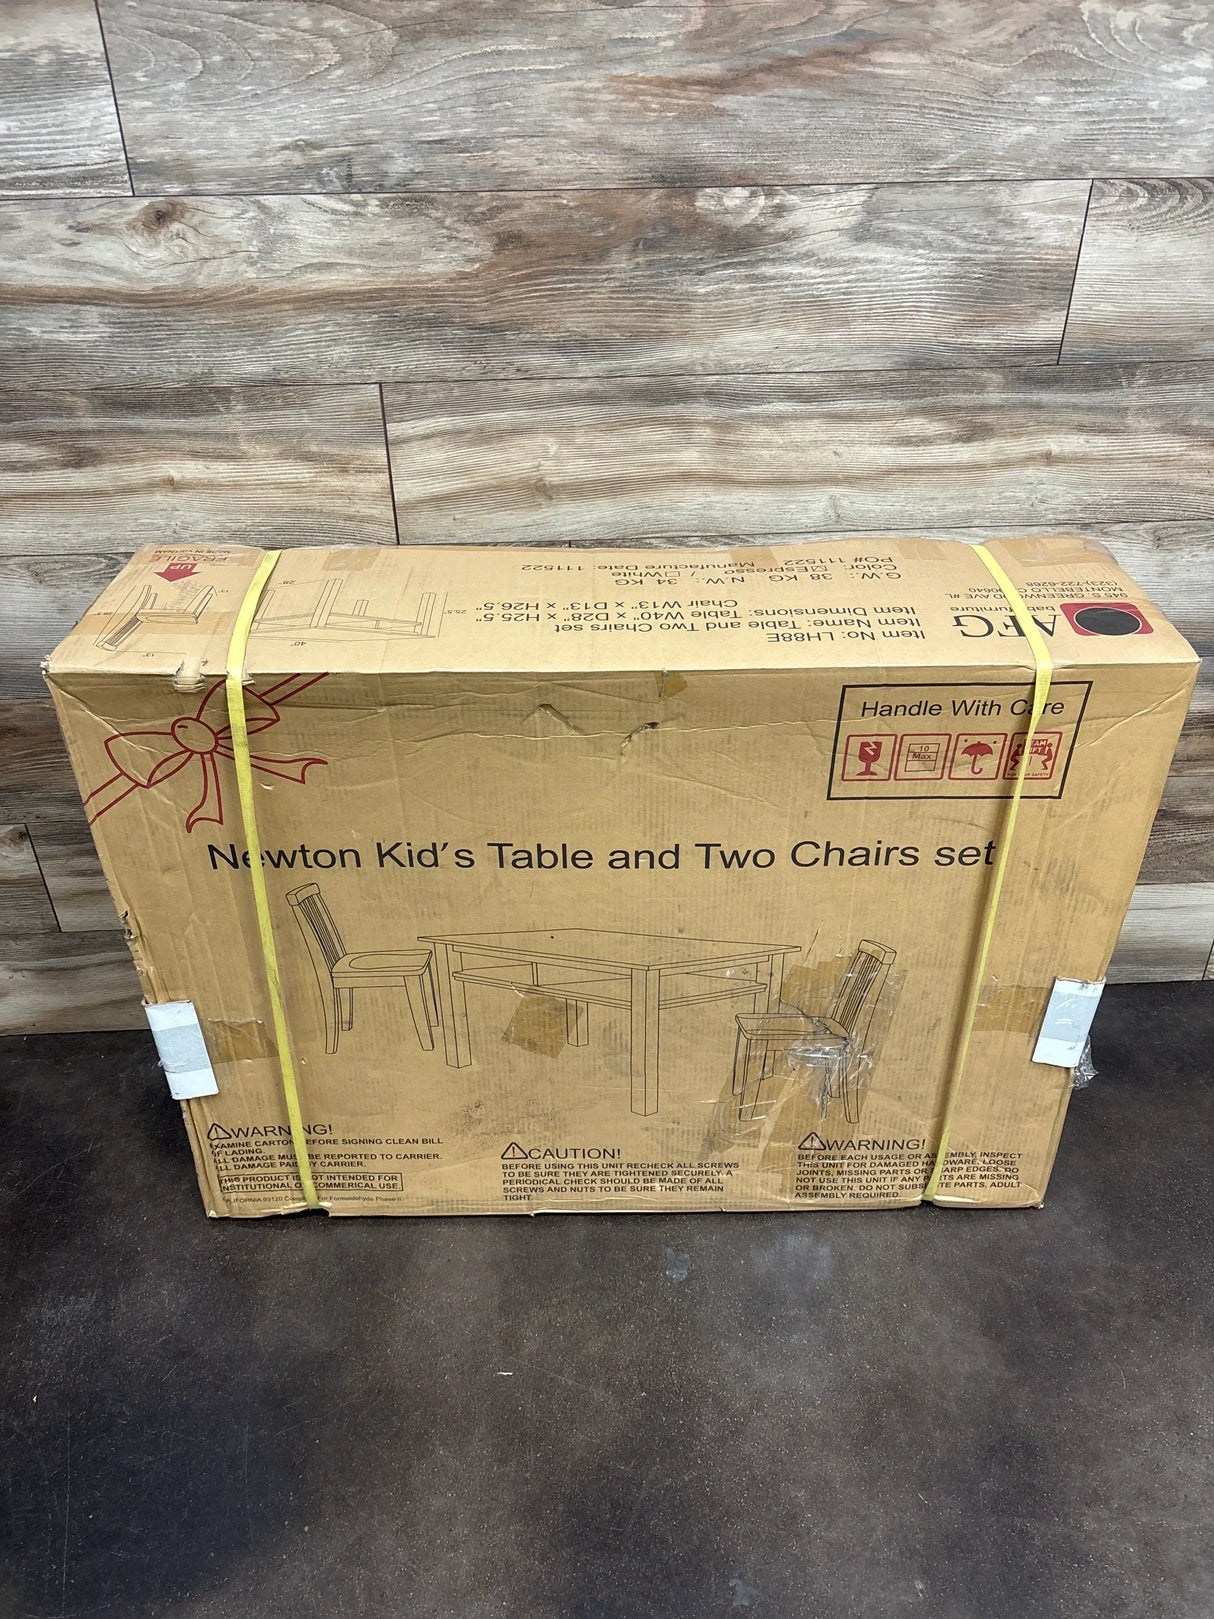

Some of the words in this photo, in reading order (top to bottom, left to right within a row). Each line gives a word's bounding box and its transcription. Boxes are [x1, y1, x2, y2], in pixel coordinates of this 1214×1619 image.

[149, 554, 228, 562] FRAGILE
[783, 557, 846, 565] 111522
[644, 561, 755, 570] Manufacture
[723, 565, 809, 574] Espresso
[844, 563, 897, 571] Color:
[615, 578, 644, 586] KG
[656, 578, 678, 586] 34
[768, 574, 798, 582] KG
[688, 600, 738, 608] Chair
[690, 610, 743, 619] Table
[748, 606, 868, 617] Dimensions:
[873, 606, 916, 615] Item
[705, 621, 742, 631] and
[748, 620, 802, 629] Table
[808, 618, 872, 628] Name:
[877, 617, 921, 628] Item
[952, 613, 1062, 638] AFG
[554, 623, 584, 633] set
[589, 622, 652, 633] Chairs
[659, 623, 700, 632] Two
[767, 631, 834, 643] LH88E
[842, 630, 876, 641] No:
[882, 629, 926, 640] Item
[861, 699, 942, 717] Handle
[952, 699, 1002, 717] With
[912, 752, 932, 760] Max
[376, 841, 475, 869] Kid's
[487, 842, 594, 870] Table
[608, 843, 680, 869] and
[695, 843, 776, 869] Two
[791, 840, 920, 867] Chairs
[934, 840, 997, 867] set
[231, 1123, 333, 1139] WARNNG!
[825, 1138, 926, 1151] WARNING!
[224, 1148, 266, 1157] LADING.
[528, 1147, 621, 1160] CAUTION!
[979, 1151, 1023, 1159] INSPECT
[232, 1154, 276, 1163] DAMAGE
[982, 1158, 1017, 1166] LOOSE
[233, 1162, 277, 1170] DAMAGE
[319, 1160, 367, 1168] CARRIER.
[544, 1162, 575, 1170] USING
[533, 1170, 561, 1178] SURE
[796, 1169, 834, 1177] JOINTS,
[978, 1173, 1020, 1181] MISSING
[220, 1177, 240, 1185] THIS
[242, 1174, 290, 1182] PRODUCT
[502, 1178, 561, 1186] PERIODICAL
[222, 1182, 293, 1192] NSTITUTIONAL
[503, 1186, 545, 1194] SCREWS
[795, 1184, 810, 1192] OR
[812, 1184, 856, 1192] BROKEN.
[848, 1191, 901, 1199] REQUIRED.
